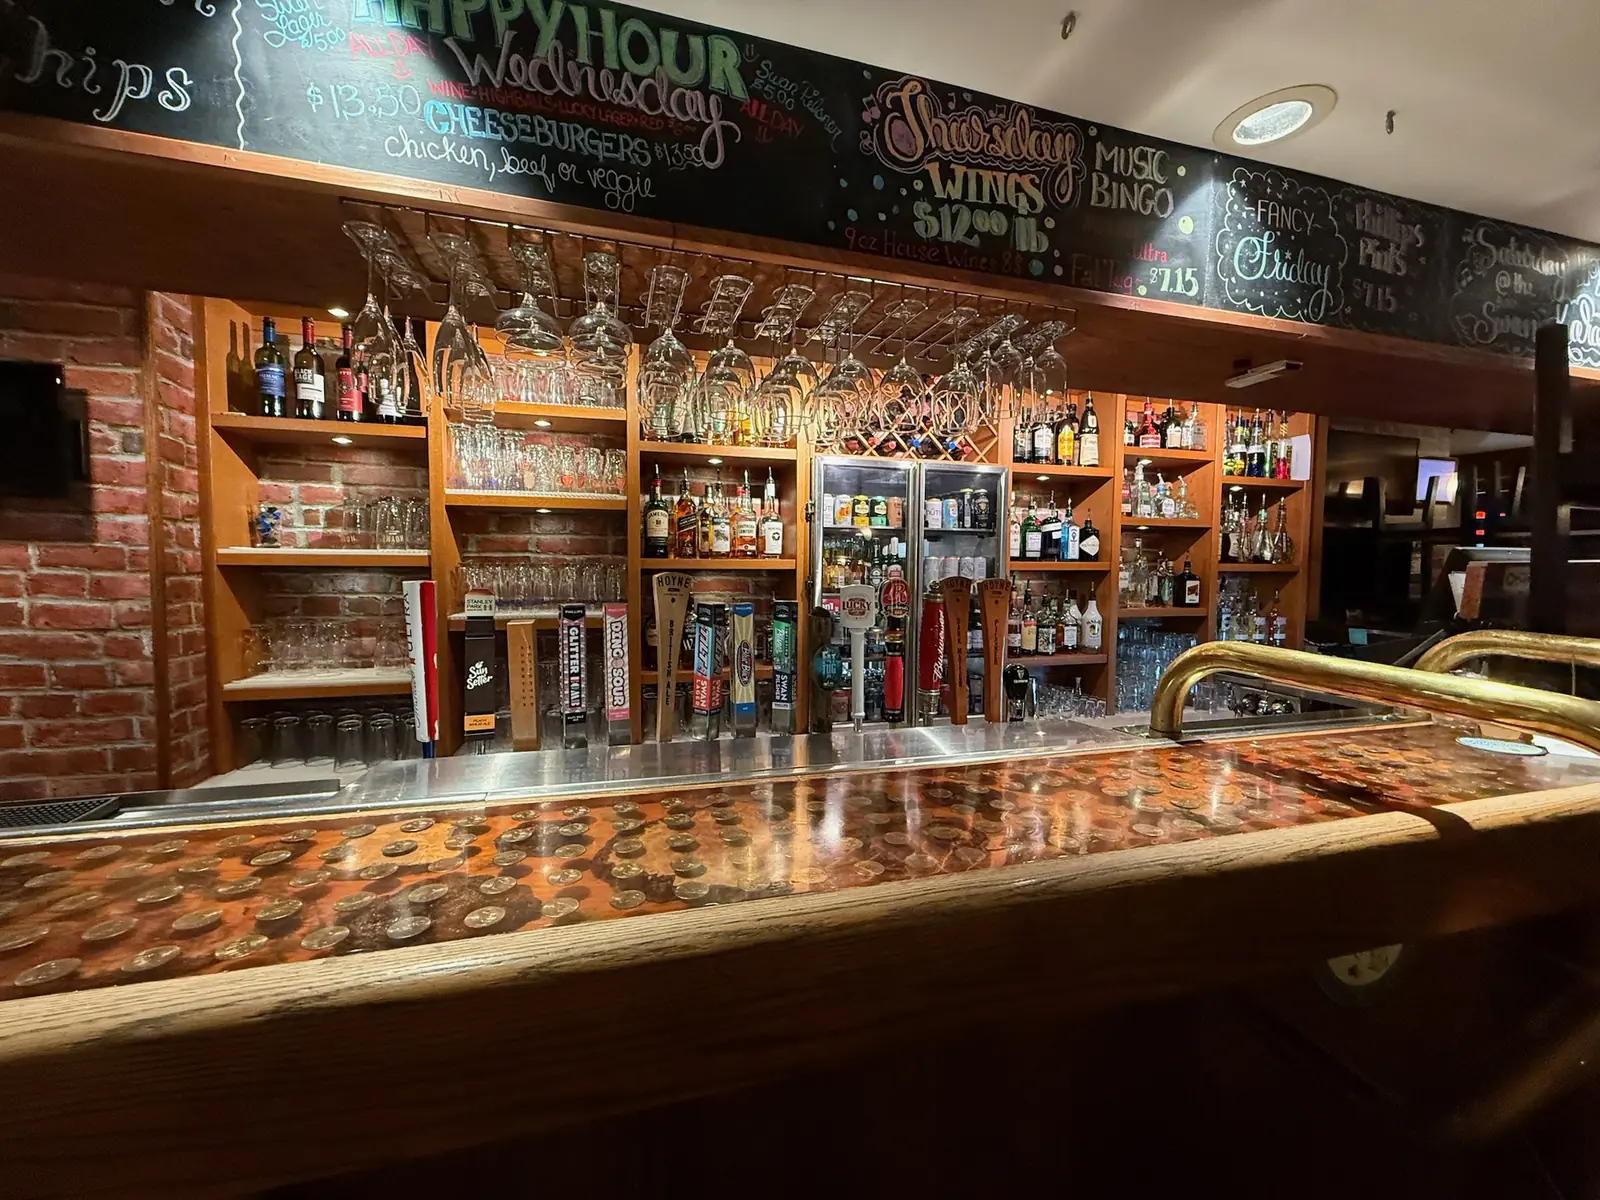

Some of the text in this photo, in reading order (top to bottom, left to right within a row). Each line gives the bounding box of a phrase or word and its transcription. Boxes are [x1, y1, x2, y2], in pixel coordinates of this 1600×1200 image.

[0, 16, 193, 122] hips
[570, 5, 749, 101] HOUR
[427, 77, 472, 101] WINE
[444, 30, 741, 169] Wednesday
[424, 99, 651, 167] CHEESEBURGERS
[884, 79, 1078, 205] Thursday
[1094, 141, 1170, 185] MUSIC
[558, 163, 585, 185] or
[587, 168, 656, 212] veggie
[923, 161, 1047, 215] WINGS
[1090, 171, 1175, 219] BINGO
[1256, 199, 1315, 236] FANCY
[883, 231, 940, 262] House
[1149, 267, 1199, 297] $7.15
[1233, 230, 1333, 323] Friday
[657, 575, 692, 588] HOYNE
[842, 600, 872, 611] LUCKY
[569, 626, 580, 675] GLITTER
[611, 620, 624, 660] DINO
[468, 665, 489, 680] Sun
[612, 667, 626, 707] SOUR
[700, 680, 708, 707] SWAN
